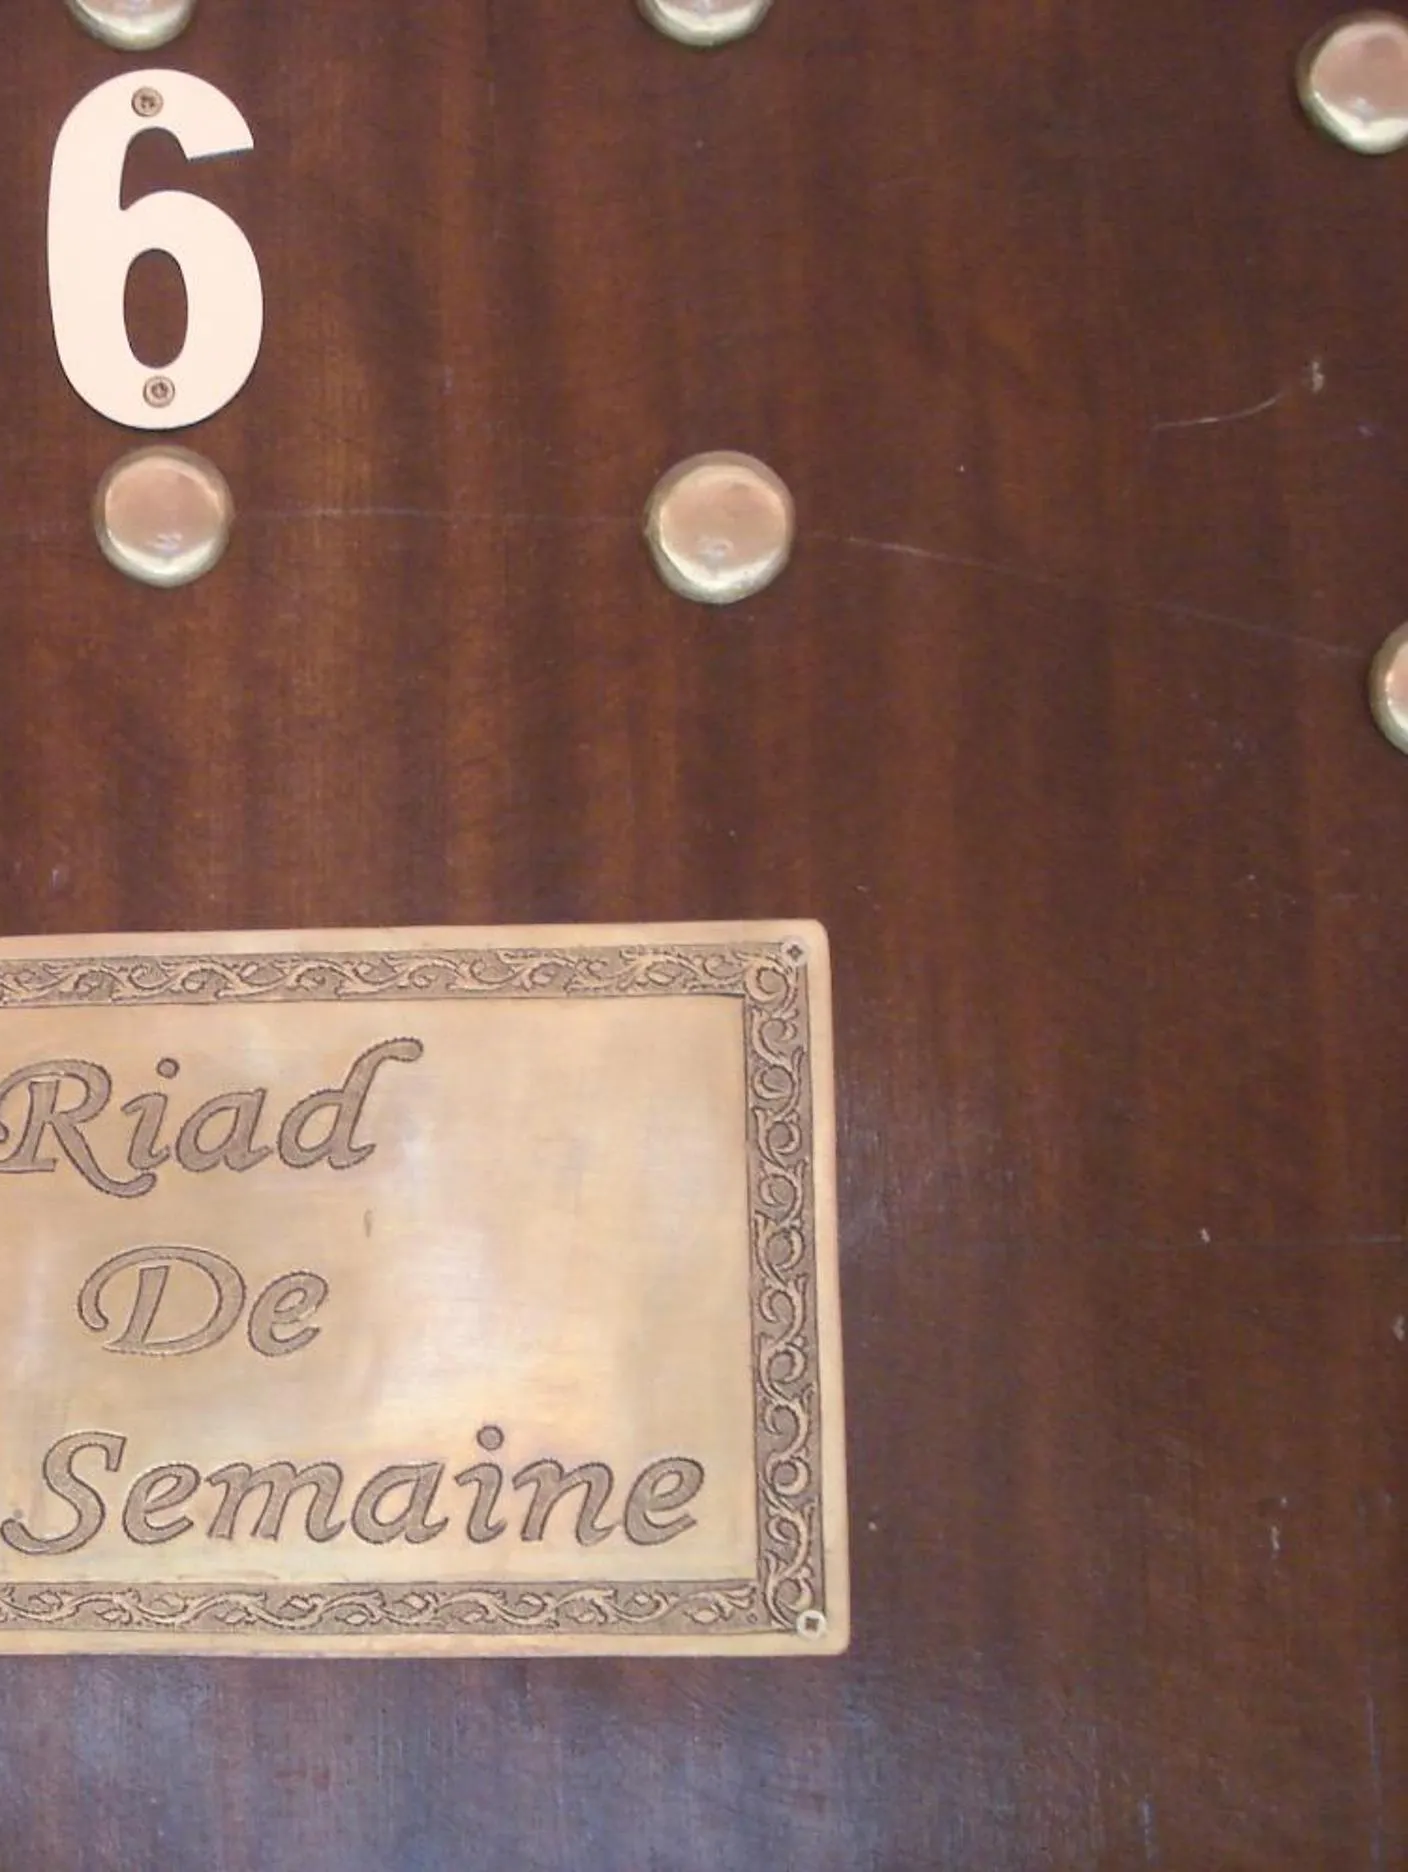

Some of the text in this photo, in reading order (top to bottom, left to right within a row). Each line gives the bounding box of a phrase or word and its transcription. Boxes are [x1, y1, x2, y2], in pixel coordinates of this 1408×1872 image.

[47, 68, 264, 430] 6
[77, 1244, 331, 1358] De
[0, 1424, 707, 1557] Semaine
